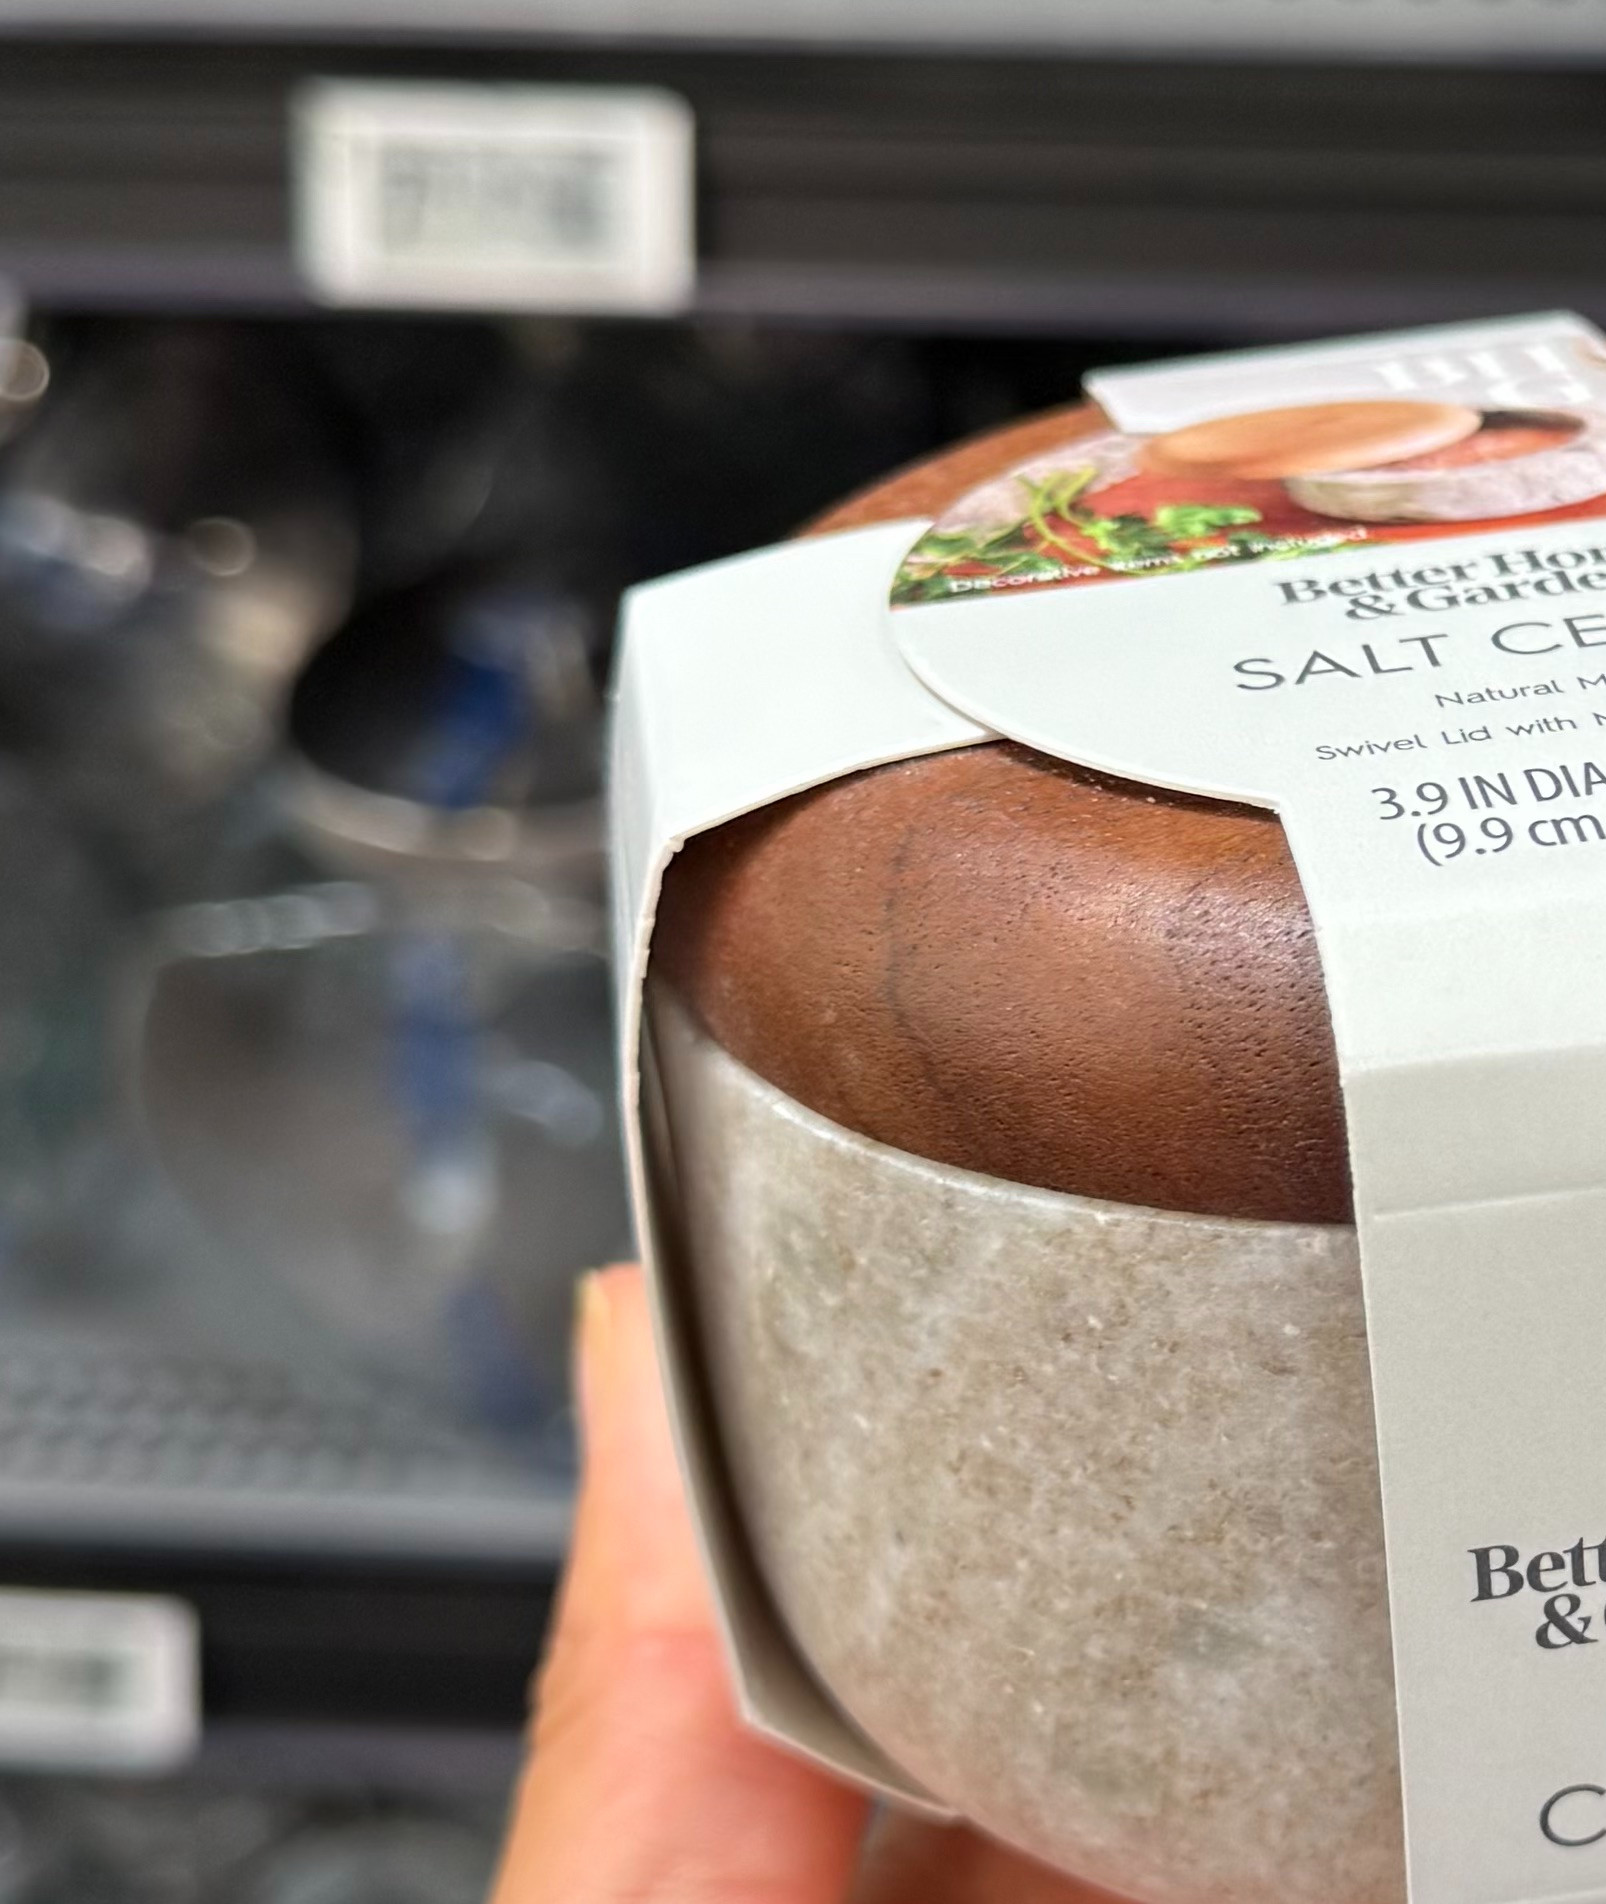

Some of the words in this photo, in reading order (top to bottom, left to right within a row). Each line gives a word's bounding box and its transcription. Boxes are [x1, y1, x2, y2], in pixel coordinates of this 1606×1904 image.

[1272, 560, 1454, 606] Better
[1232, 633, 1448, 691] SALT
[1434, 679, 1564, 708] Natural
[1315, 734, 1428, 761] Swivel
[1441, 725, 1492, 745] Lid
[1505, 716, 1578, 737] with
[1371, 781, 1449, 821] 3.9
[1457, 772, 1518, 810] IN
[1417, 816, 1514, 867] (9.9
[1527, 814, 1606, 847] cm
